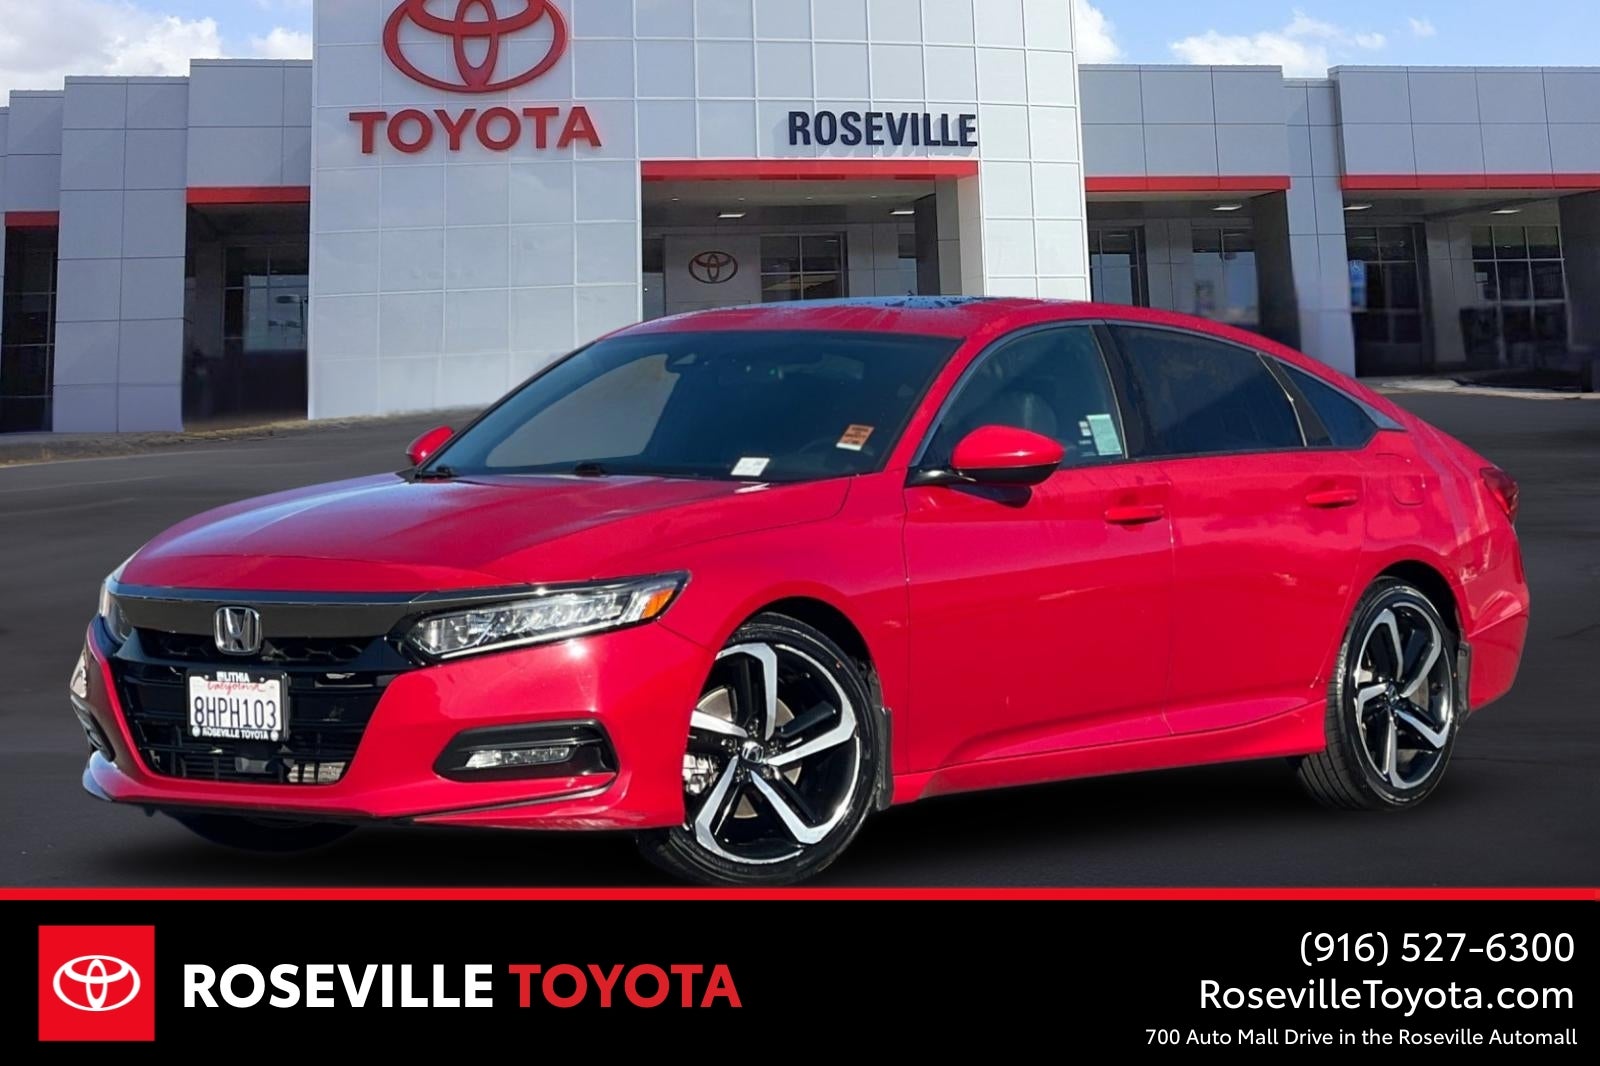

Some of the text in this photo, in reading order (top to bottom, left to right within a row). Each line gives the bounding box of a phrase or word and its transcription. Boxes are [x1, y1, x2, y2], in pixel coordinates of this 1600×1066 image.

[348, 105, 602, 154] TOYOTA
[787, 110, 978, 147] ROSEVILLE
[194, 696, 276, 728] 8HPH103
[202, 727, 269, 740] ROSEVILLE TOYOTA
